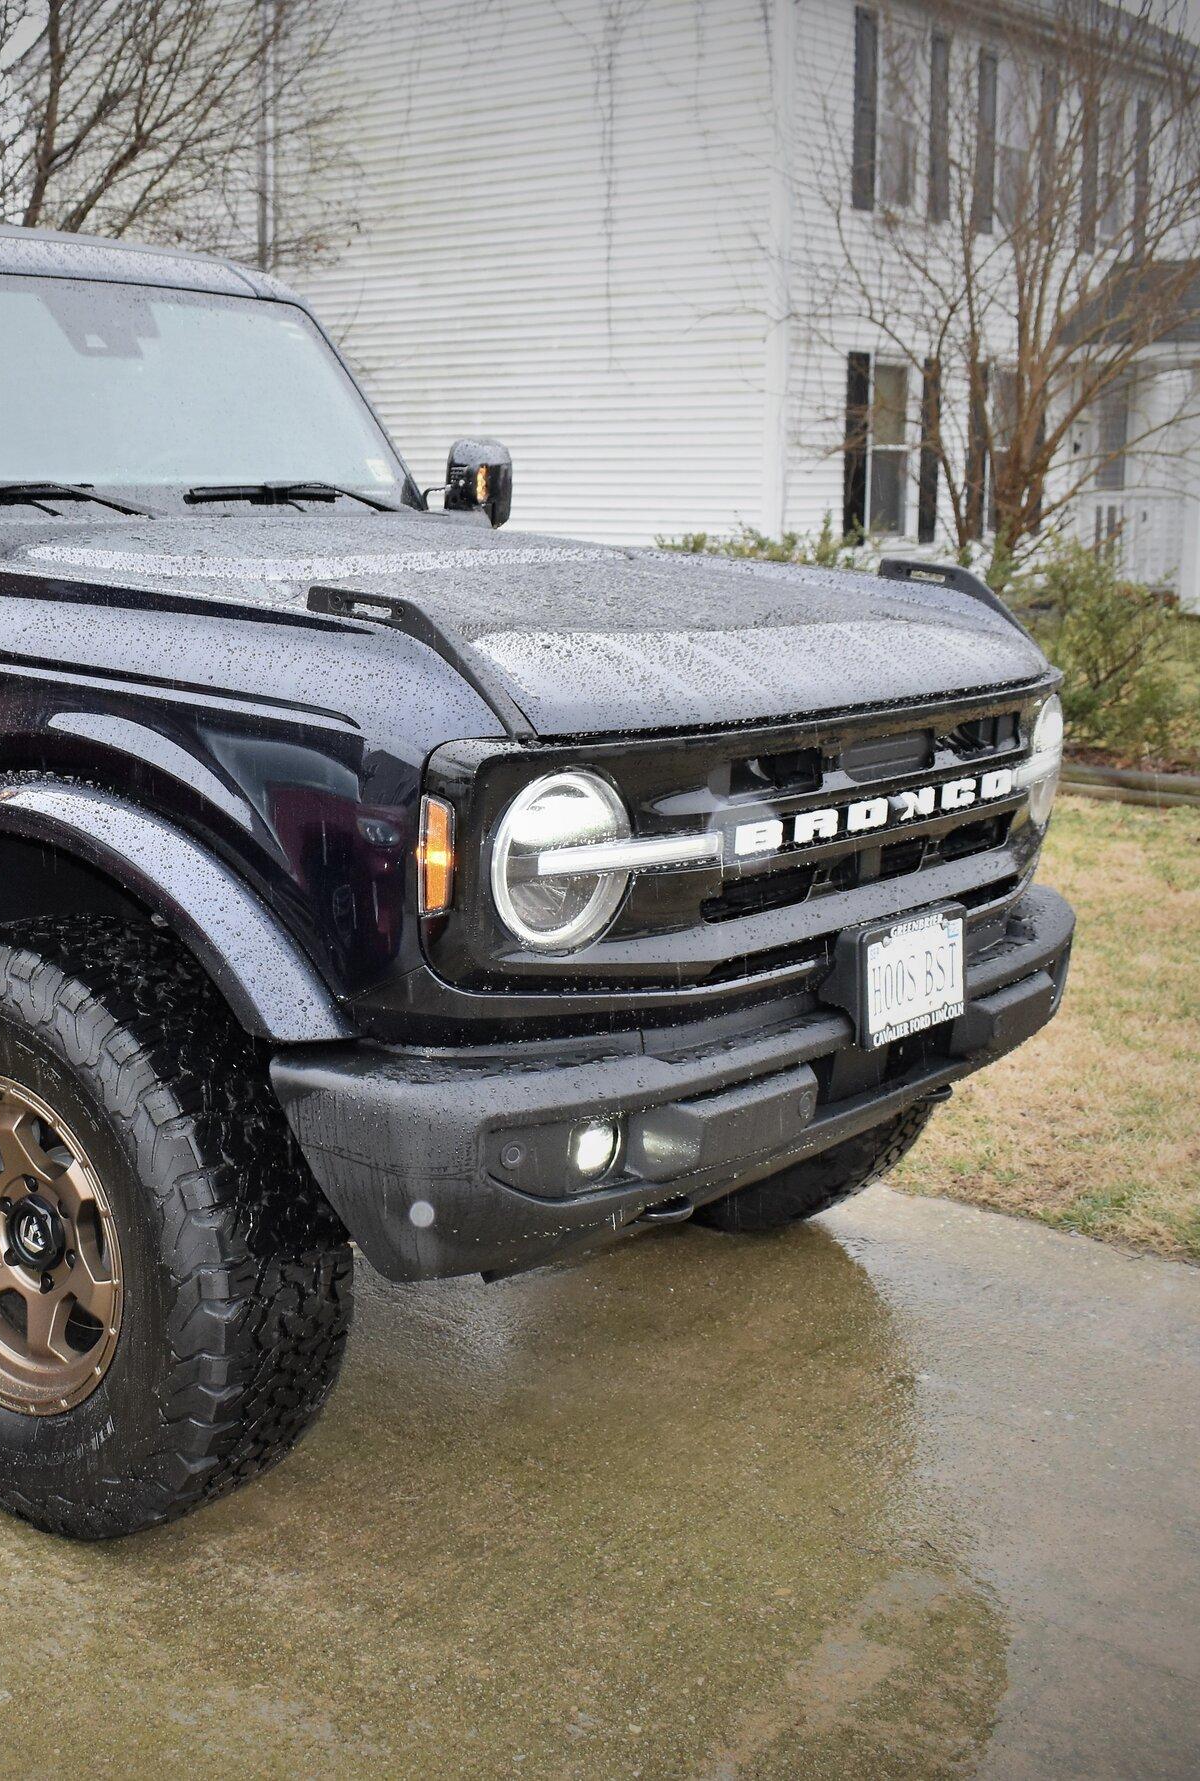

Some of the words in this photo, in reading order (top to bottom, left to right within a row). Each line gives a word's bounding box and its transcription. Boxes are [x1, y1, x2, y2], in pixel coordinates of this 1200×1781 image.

[734, 769, 1012, 856] BRONCO
[890, 914, 943, 938] GREENBRIER
[872, 955, 916, 1016] HOOS
[925, 942, 957, 996] BST
[873, 1021, 910, 1047] CAVALIER
[910, 1014, 930, 1033] FORD
[932, 1003, 964, 1024] LINCOLN
